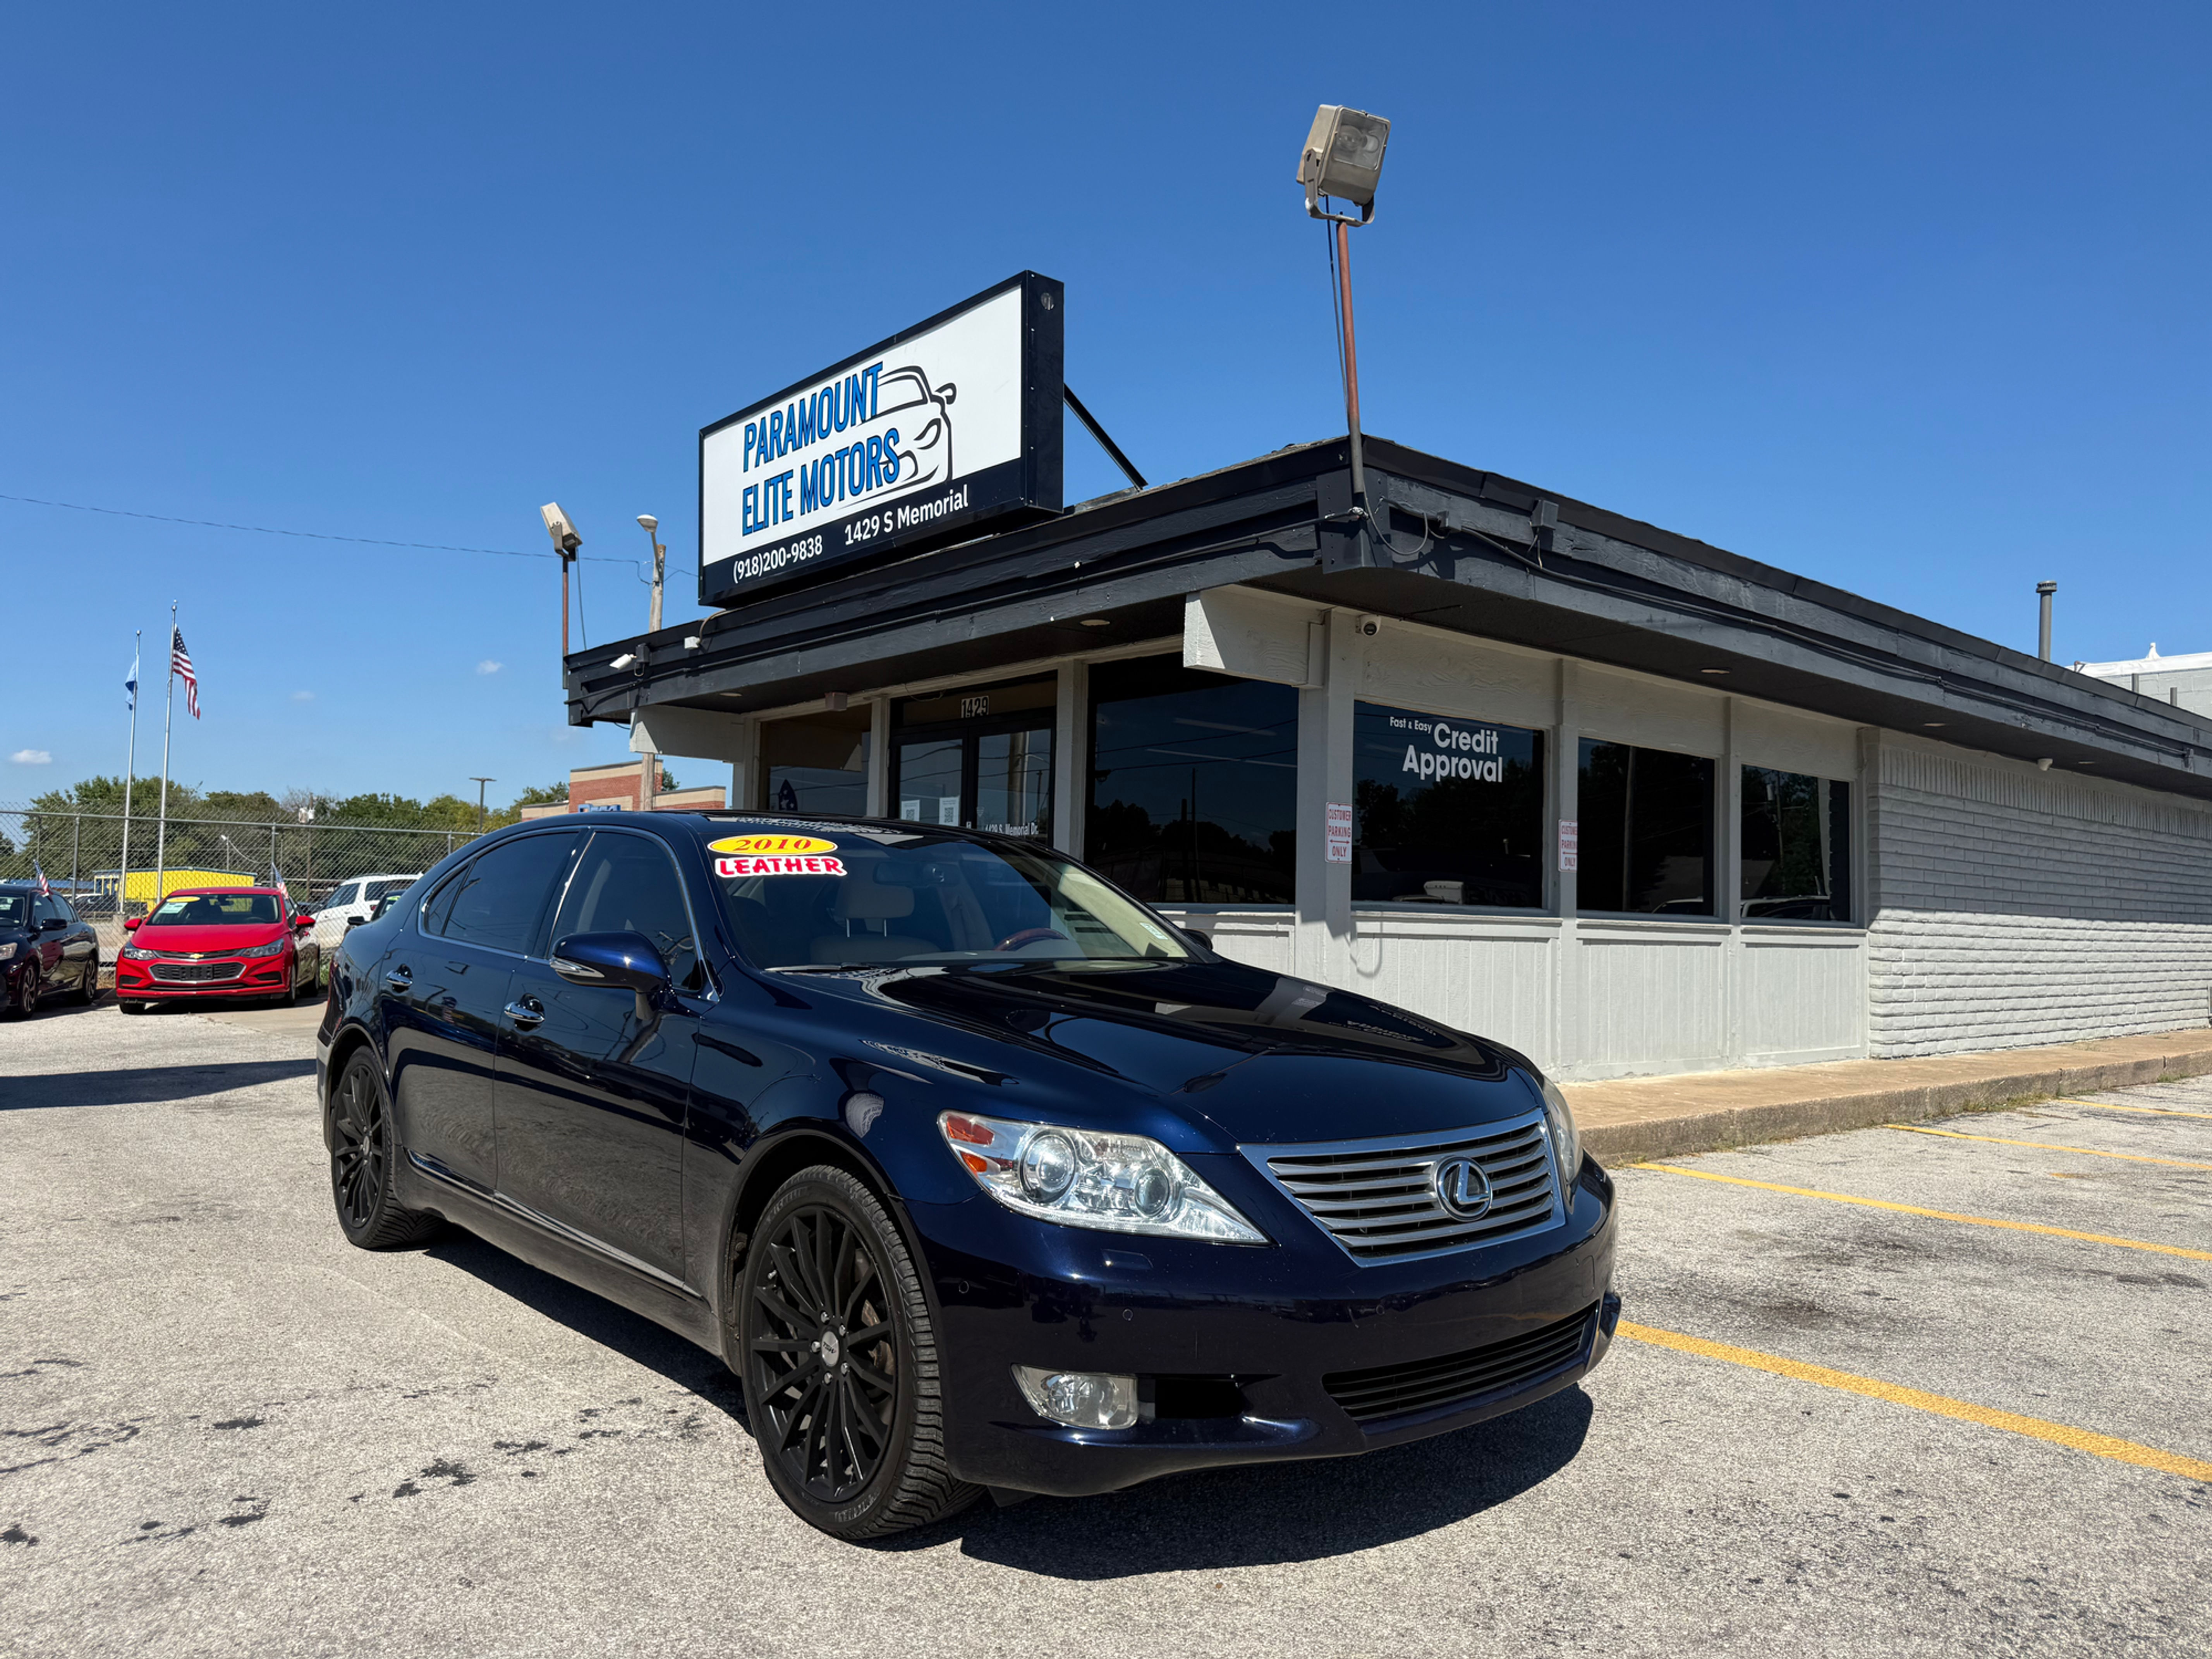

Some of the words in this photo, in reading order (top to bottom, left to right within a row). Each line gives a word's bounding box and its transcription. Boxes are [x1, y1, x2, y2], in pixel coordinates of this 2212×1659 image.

[743, 361, 883, 473] PARAMOUNT
[742, 469, 793, 537] ELITE
[800, 428, 900, 516] MOTORS
[733, 535, 823, 584] (918)200-9838
[845, 515, 879, 545] 1429
[883, 511, 893, 533] S
[897, 484, 969, 529] Memorial
[963, 697, 988, 718] 1429
[1390, 716, 1407, 728] Fast
[1408, 721, 1412, 729] &
[1414, 720, 1432, 734] Easy
[1434, 723, 1498, 755] Credit
[1402, 744, 1503, 783] Approval
[1329, 808, 1351, 821] CUSTOMER
[1005, 823, 1030, 836] Memorial
[1328, 825, 1351, 838] PARKING
[1561, 825, 1577, 835] CUSTOME
[732, 838, 812, 851] 2010
[1332, 845, 1346, 857] ONLY
[1561, 840, 1577, 850] PARKIN
[720, 858, 843, 875] LEATHER
[1565, 857, 1576, 867] ONLY
